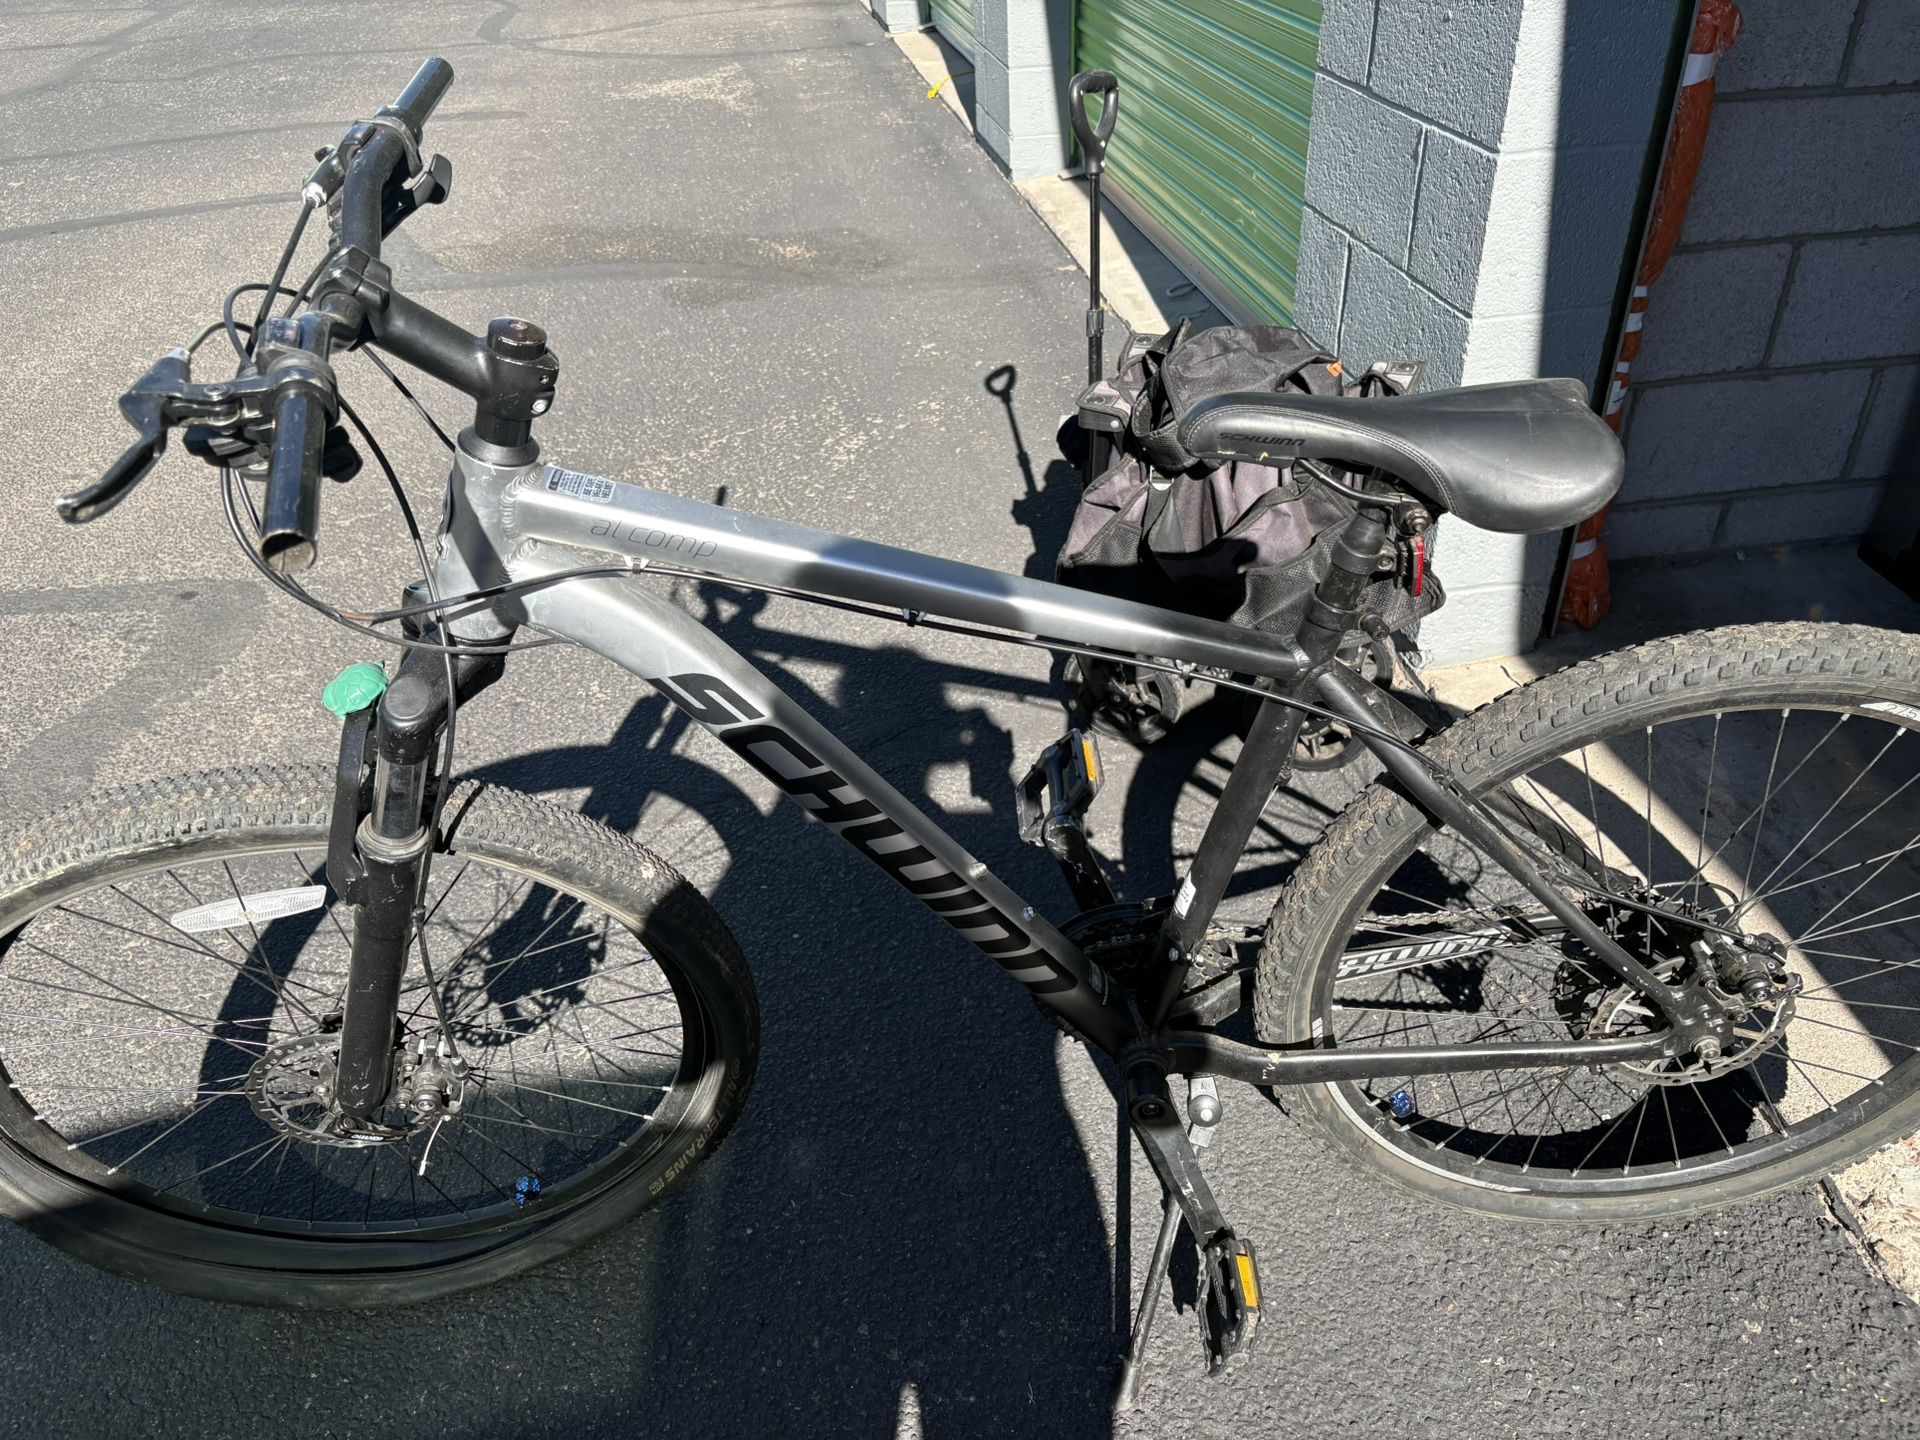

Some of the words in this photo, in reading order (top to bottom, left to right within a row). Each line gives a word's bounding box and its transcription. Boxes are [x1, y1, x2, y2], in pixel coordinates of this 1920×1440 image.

[1217, 431, 1306, 447] SCHWINN
[628, 526, 719, 560] comp
[646, 672, 1079, 994] SCHWINN
[664, 1109, 724, 1182] TERRAINS
